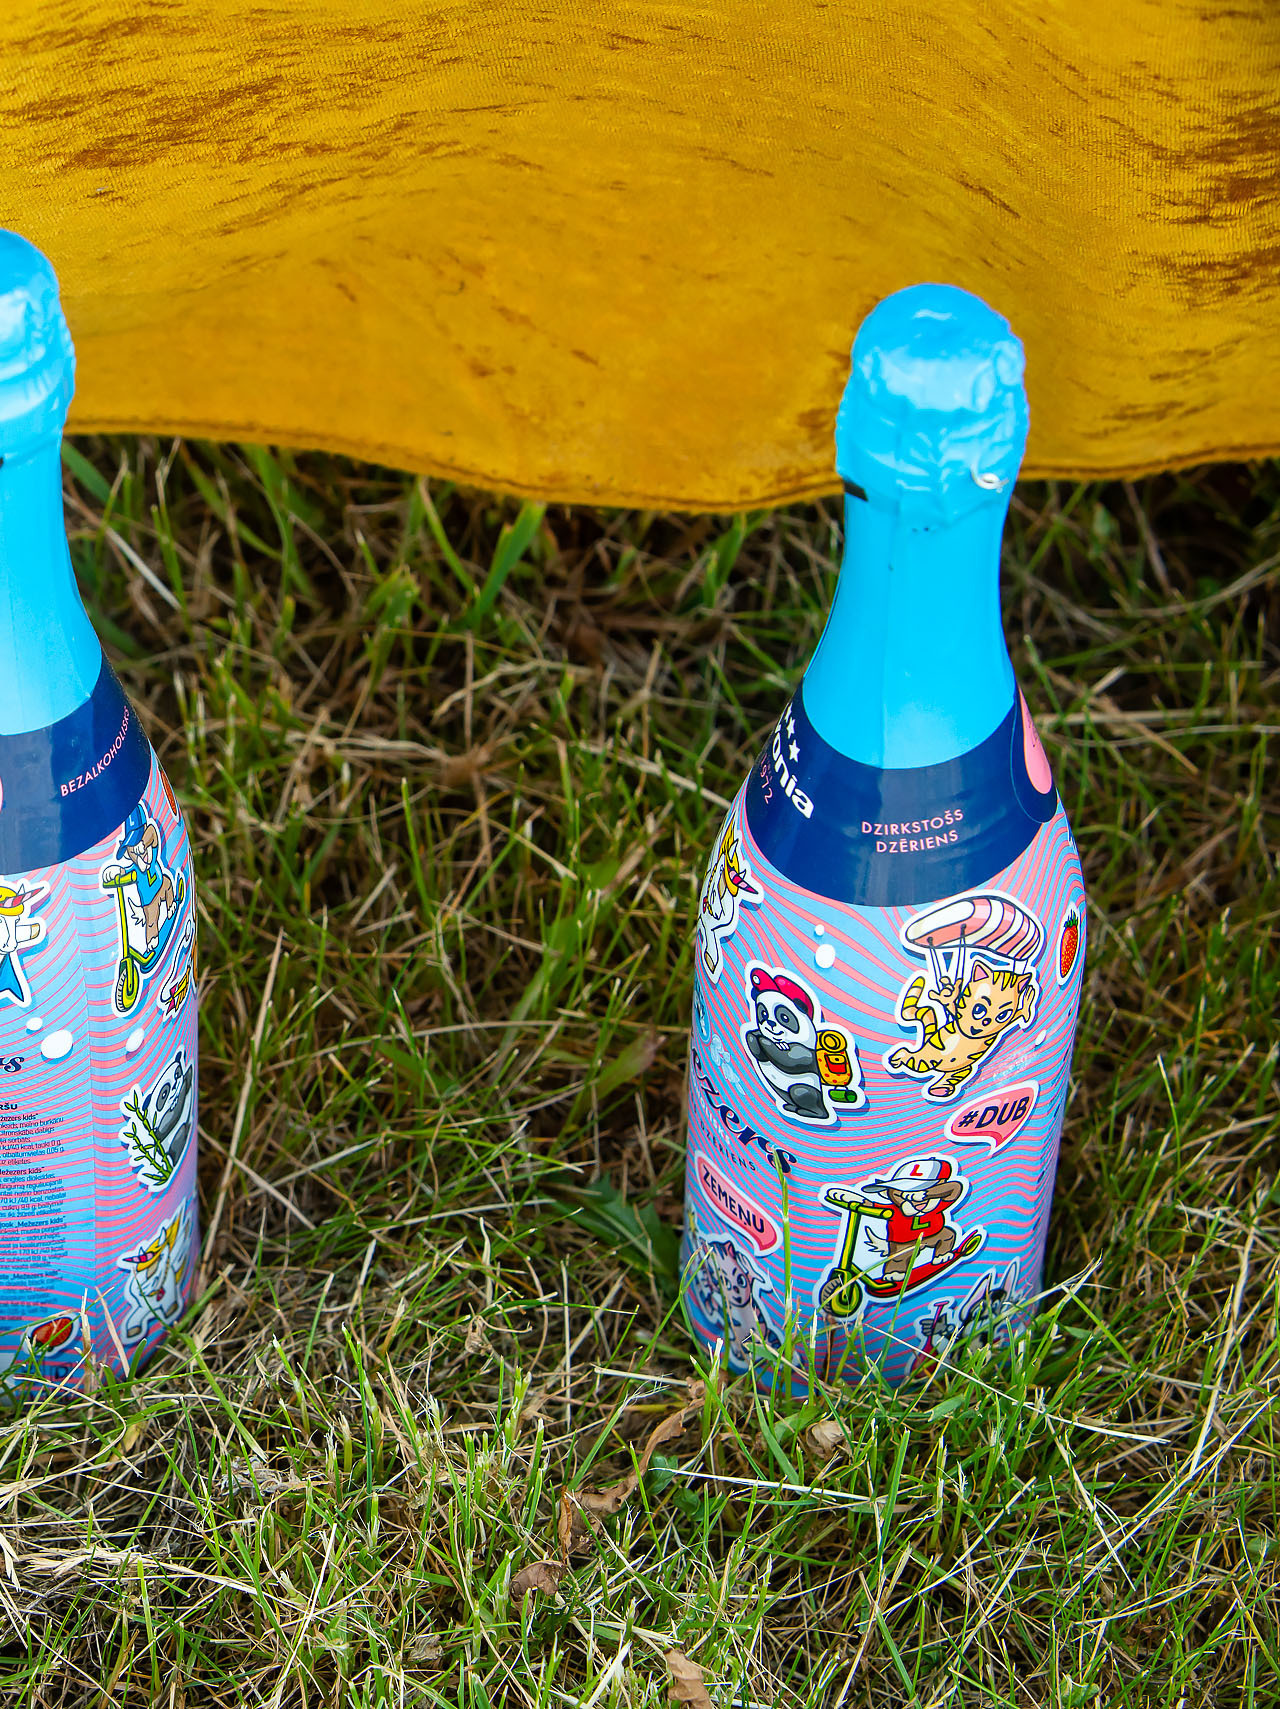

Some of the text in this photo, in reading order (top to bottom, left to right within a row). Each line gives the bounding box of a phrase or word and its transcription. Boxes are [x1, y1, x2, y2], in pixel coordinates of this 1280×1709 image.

[861, 808, 964, 837] DZIRKSTOŠS
[876, 829, 959, 854] DZĒRIENS
[958, 1096, 1030, 1129] #DUB
[910, 1163, 923, 1177] L
[911, 1216, 931, 1231] L
